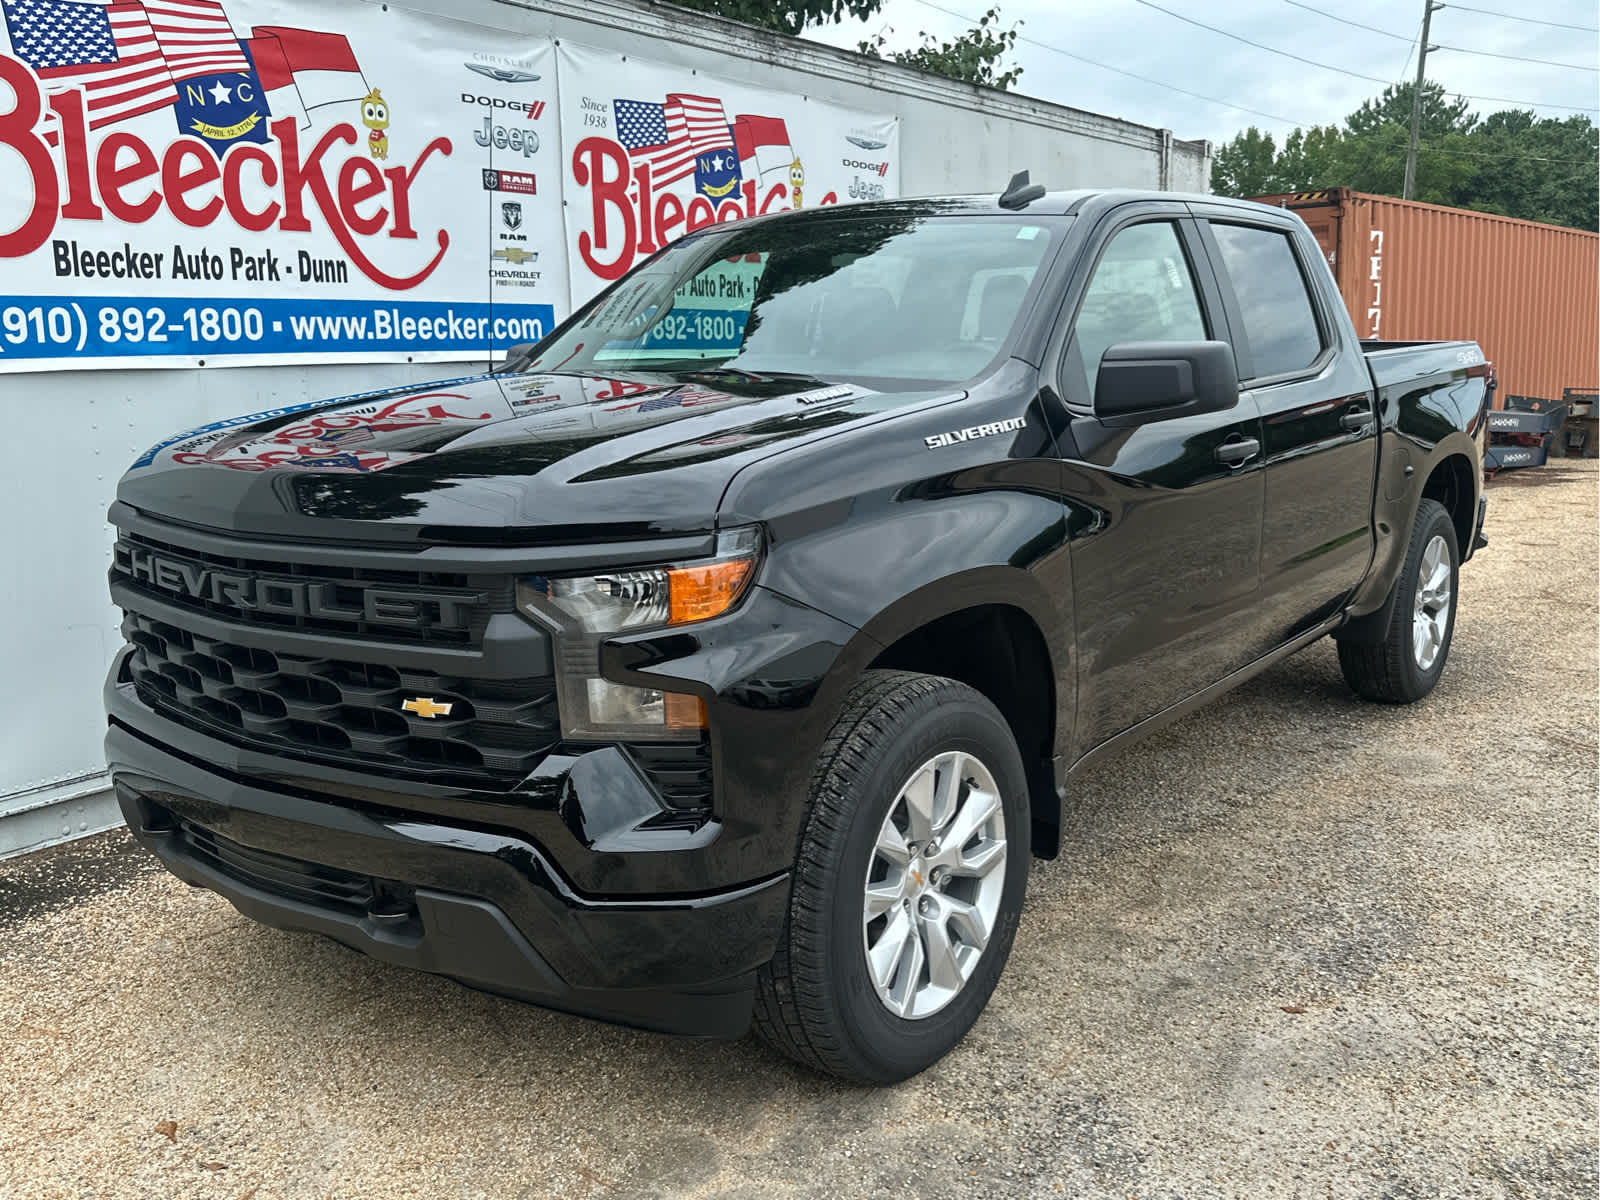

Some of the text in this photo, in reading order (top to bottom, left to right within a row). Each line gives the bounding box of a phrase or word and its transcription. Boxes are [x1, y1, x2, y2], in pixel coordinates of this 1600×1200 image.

[186, 82, 254, 106] N C
[461, 93, 535, 113] DODGE
[580, 96, 608, 112] Since
[584, 113, 608, 128] 1938
[474, 116, 540, 158] Jeep
[700, 155, 735, 174] N C
[842, 159, 881, 172] DODGE
[502, 174, 533, 184] RAM
[499, 233, 528, 241] RAM
[53, 239, 349, 284] Bleecker Auto Park Dunn
[488, 269, 541, 280] CHEVROLET
[690, 275, 716, 297] Auto
[720, 273, 744, 298] Park
[0, 302, 543, 352] 910) 892-1800 www.Bleecker.com
[653, 315, 735, 341] 892-1800
[924, 416, 1026, 449] SILVERADO
[113, 541, 488, 630] CHEVROLET
